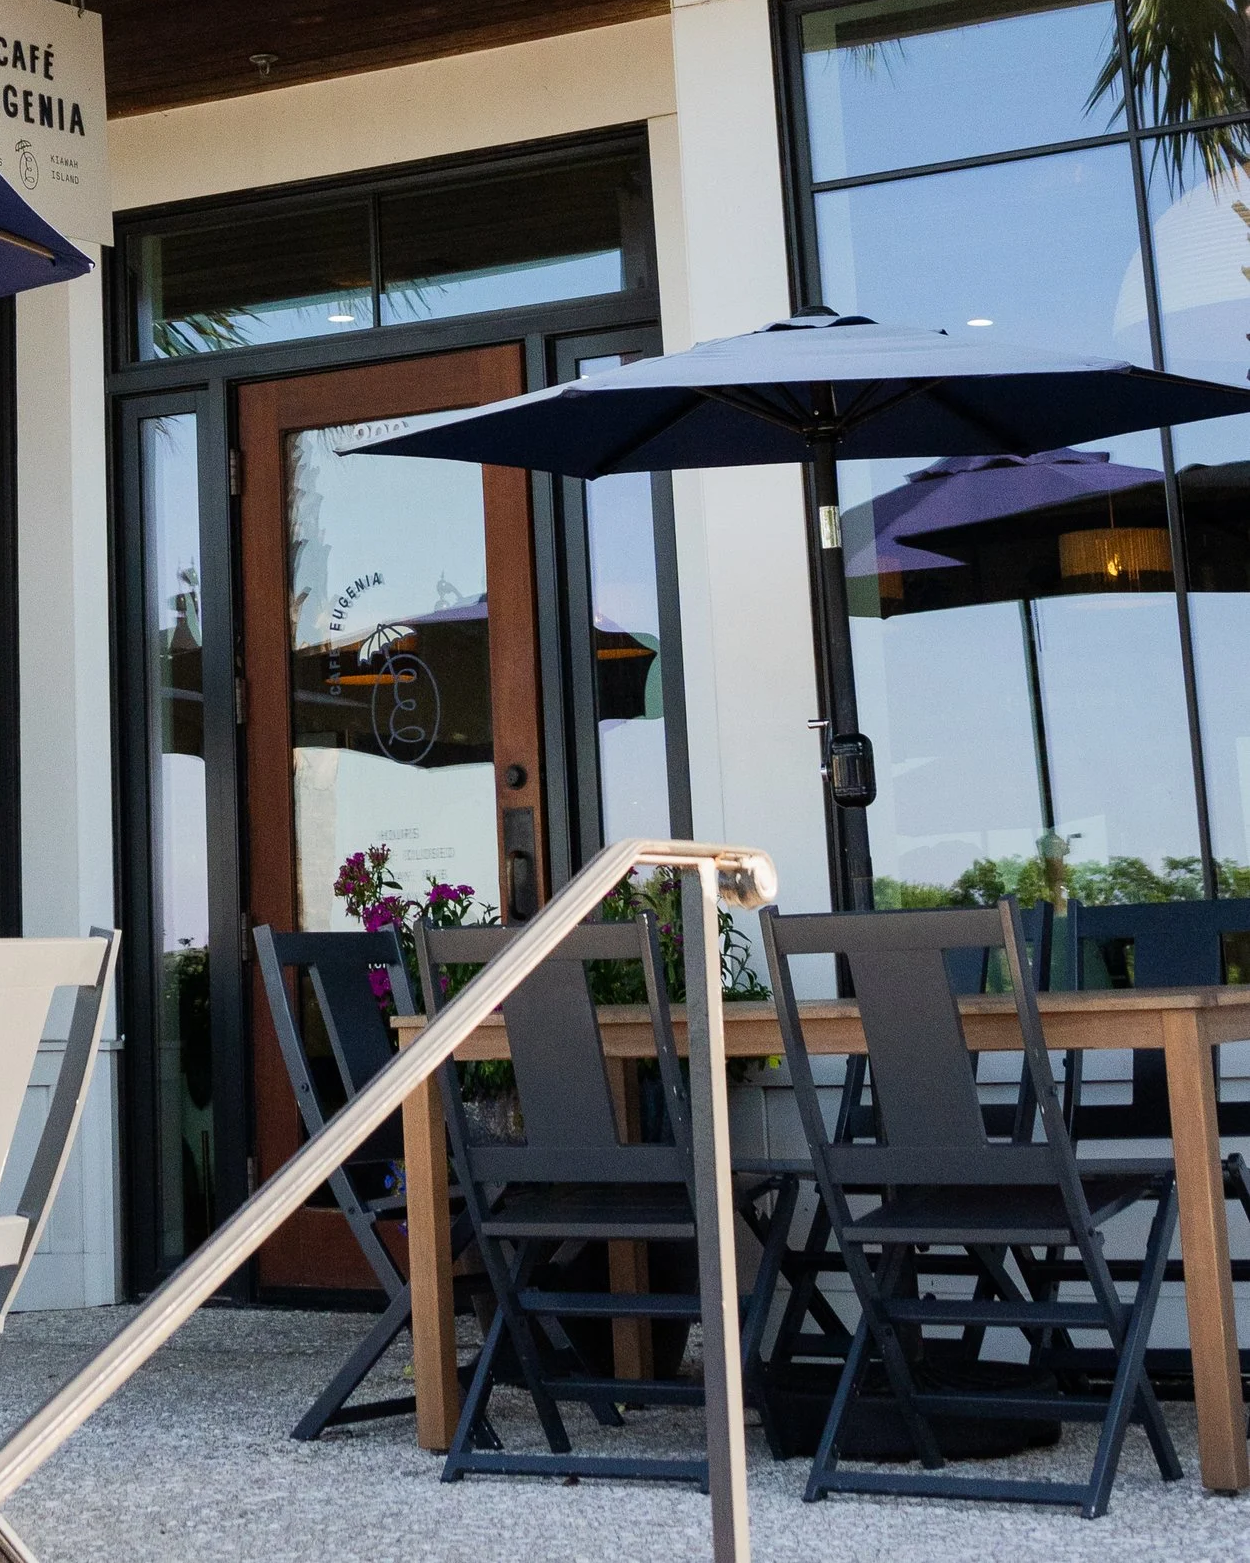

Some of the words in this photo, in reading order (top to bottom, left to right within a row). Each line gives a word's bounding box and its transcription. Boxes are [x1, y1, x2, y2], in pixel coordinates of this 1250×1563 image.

[50, 154, 79, 168] KIAWAH
[51, 170, 80, 185] ISLAND
[330, 572, 383, 632] EUGENIA
